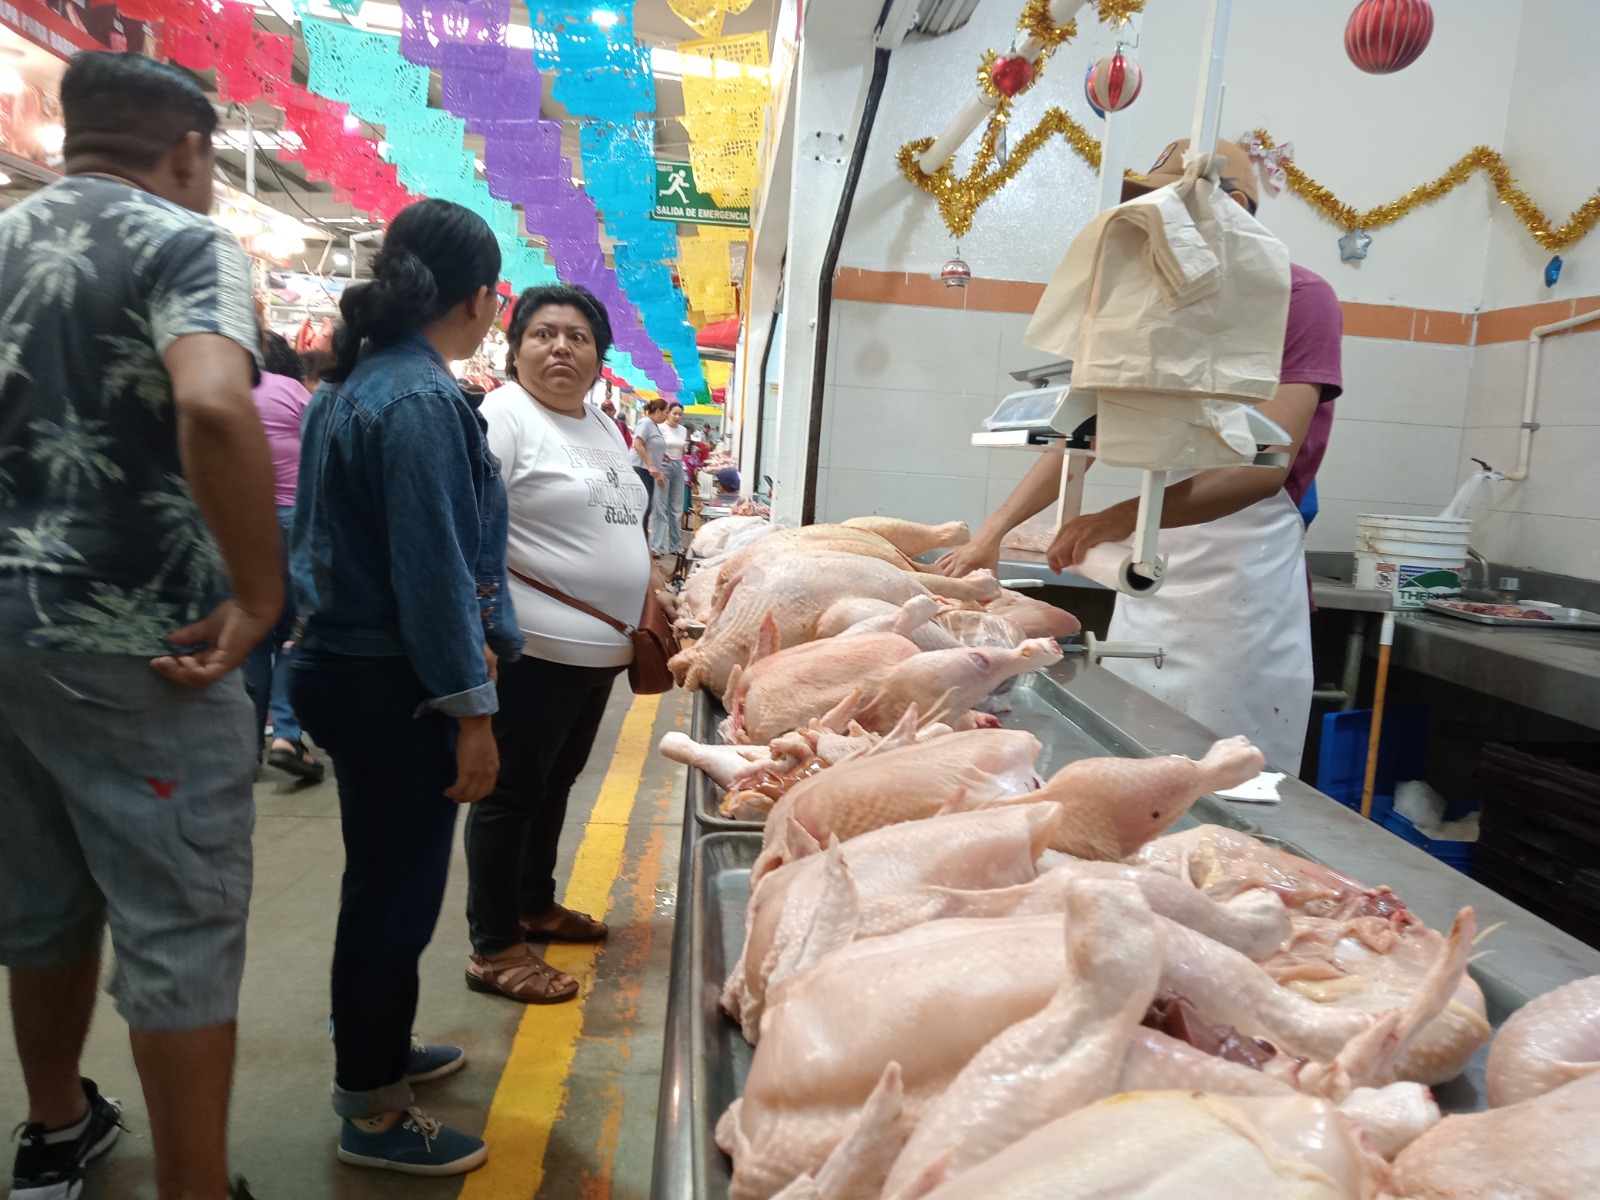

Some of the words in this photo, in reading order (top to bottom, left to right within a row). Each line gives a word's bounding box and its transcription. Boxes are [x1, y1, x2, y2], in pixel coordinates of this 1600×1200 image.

[656, 205, 685, 216] SALIDA
[686, 207, 698, 217] DE
[698, 208, 749, 221] EMERGENCIA
[561, 444, 635, 473] PEAC
[604, 503, 638, 526] studio
